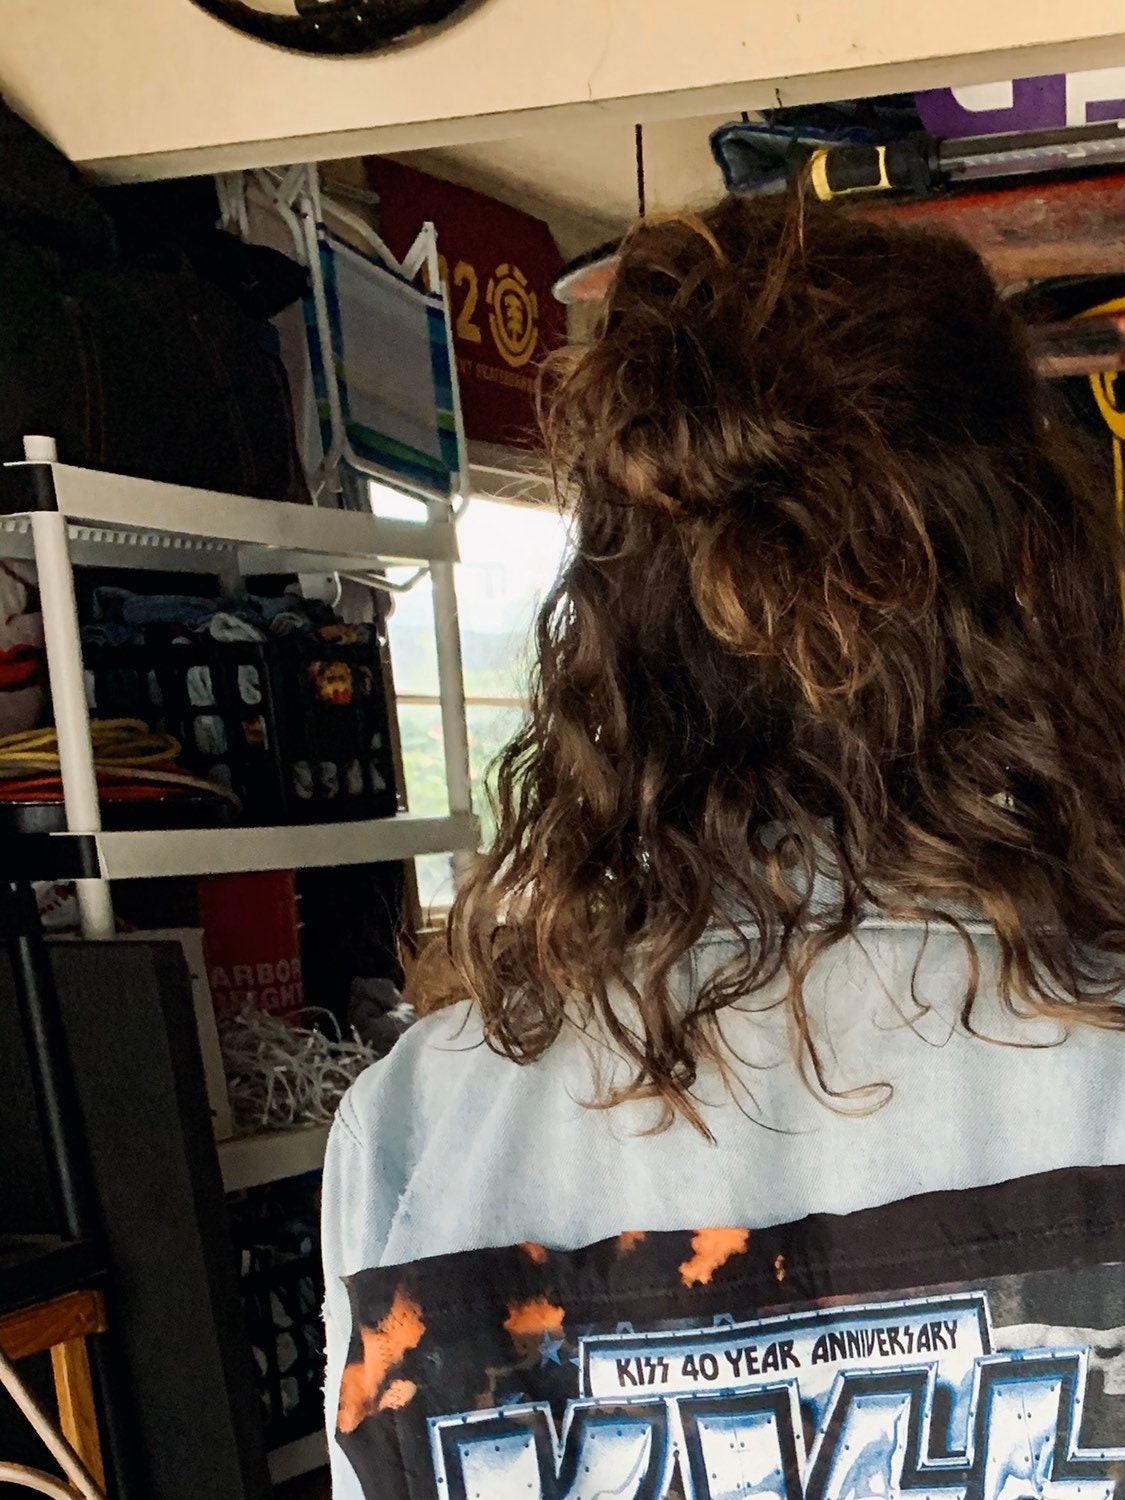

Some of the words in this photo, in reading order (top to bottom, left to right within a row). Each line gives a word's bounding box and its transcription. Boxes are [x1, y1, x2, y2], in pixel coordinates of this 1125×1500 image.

[615, 1356, 669, 1388] KISS
[681, 1352, 720, 1381] 40
[726, 1340, 801, 1377] YEAR
[811, 1319, 960, 1365] ANNIVERSARY
